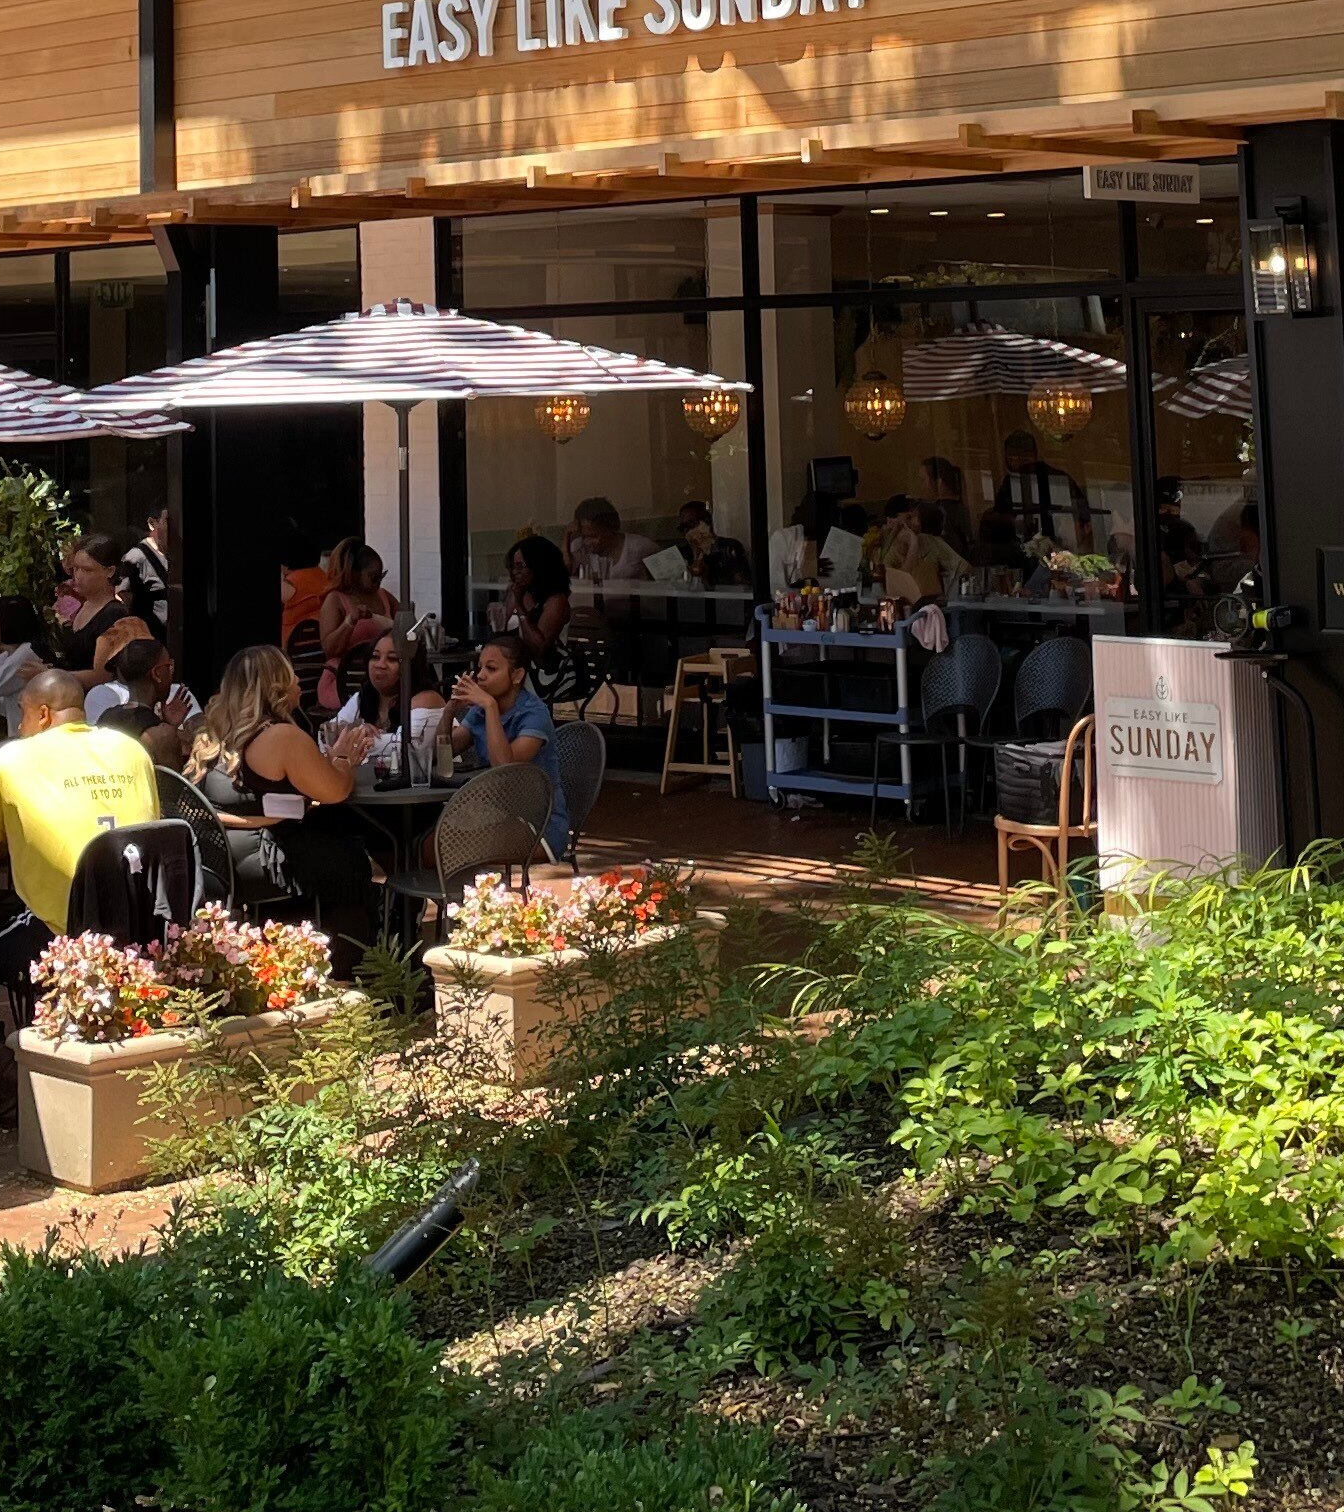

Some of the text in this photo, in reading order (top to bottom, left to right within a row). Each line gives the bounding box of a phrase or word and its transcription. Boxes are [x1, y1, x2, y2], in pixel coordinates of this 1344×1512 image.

[1096, 169, 1194, 194] EASY LIKE SUNDAY
[1133, 709, 1188, 723] EASY LIKE
[1110, 724, 1216, 763] SUNDAY
[64, 777, 79, 788] ALL
[81, 775, 106, 785] THERE
[109, 774, 116, 784] IS
[117, 774, 126, 784] TO
[91, 788, 123, 800] IS TO DO
